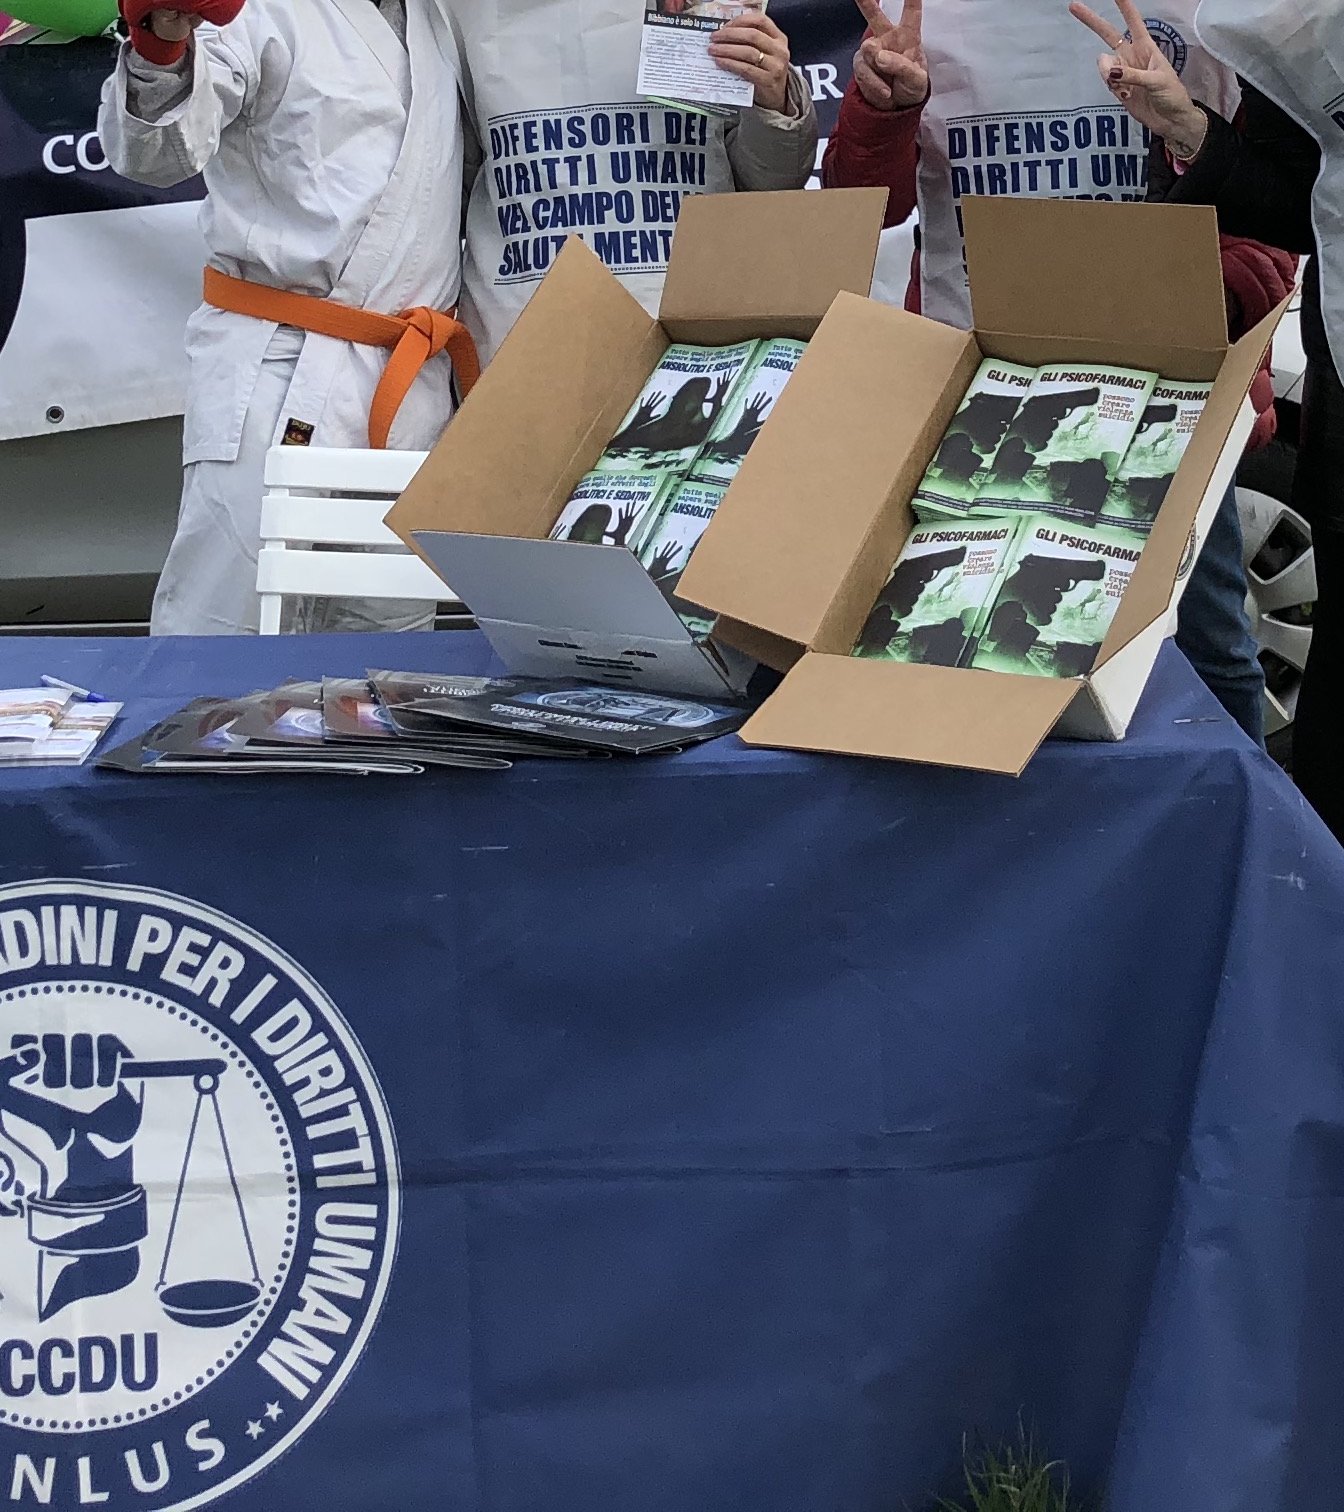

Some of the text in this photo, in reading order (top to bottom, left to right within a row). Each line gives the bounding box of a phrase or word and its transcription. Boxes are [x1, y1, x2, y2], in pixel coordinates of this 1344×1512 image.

[647, 13, 674, 26] Bibbiano
[681, 17, 693, 26] solo
[694, 18, 700, 28] la
[700, 20, 718, 30] punta
[490, 112, 708, 160] DIFENSORI DEI
[947, 114, 1130, 160] DIFENSORI
[494, 150, 707, 200] DIRITTI UMANI
[951, 157, 1078, 199] DIRITTI
[497, 203, 532, 237] NEL
[532, 190, 635, 230] CAMPO
[498, 230, 586, 277] SALUT
[658, 361, 706, 374] ANSIOLITICI
[705, 364, 712, 373] E
[987, 369, 1007, 383] GLI
[1040, 372, 1147, 390] GLI PSICOFARMACI
[1102, 393, 1136, 403] possono
[1102, 400, 1131, 409] creare
[1098, 413, 1135, 422] suicidio
[606, 489, 652, 502] E SEDATIVI
[912, 528, 1009, 545] GLI PSICOFARMACI
[1035, 527, 1057, 542] GLI
[125, 913, 246, 1008] PER
[229, 972, 279, 1026] I
[249, 997, 378, 1190] DIRITTI
[255, 1201, 379, 1403] UMANI
